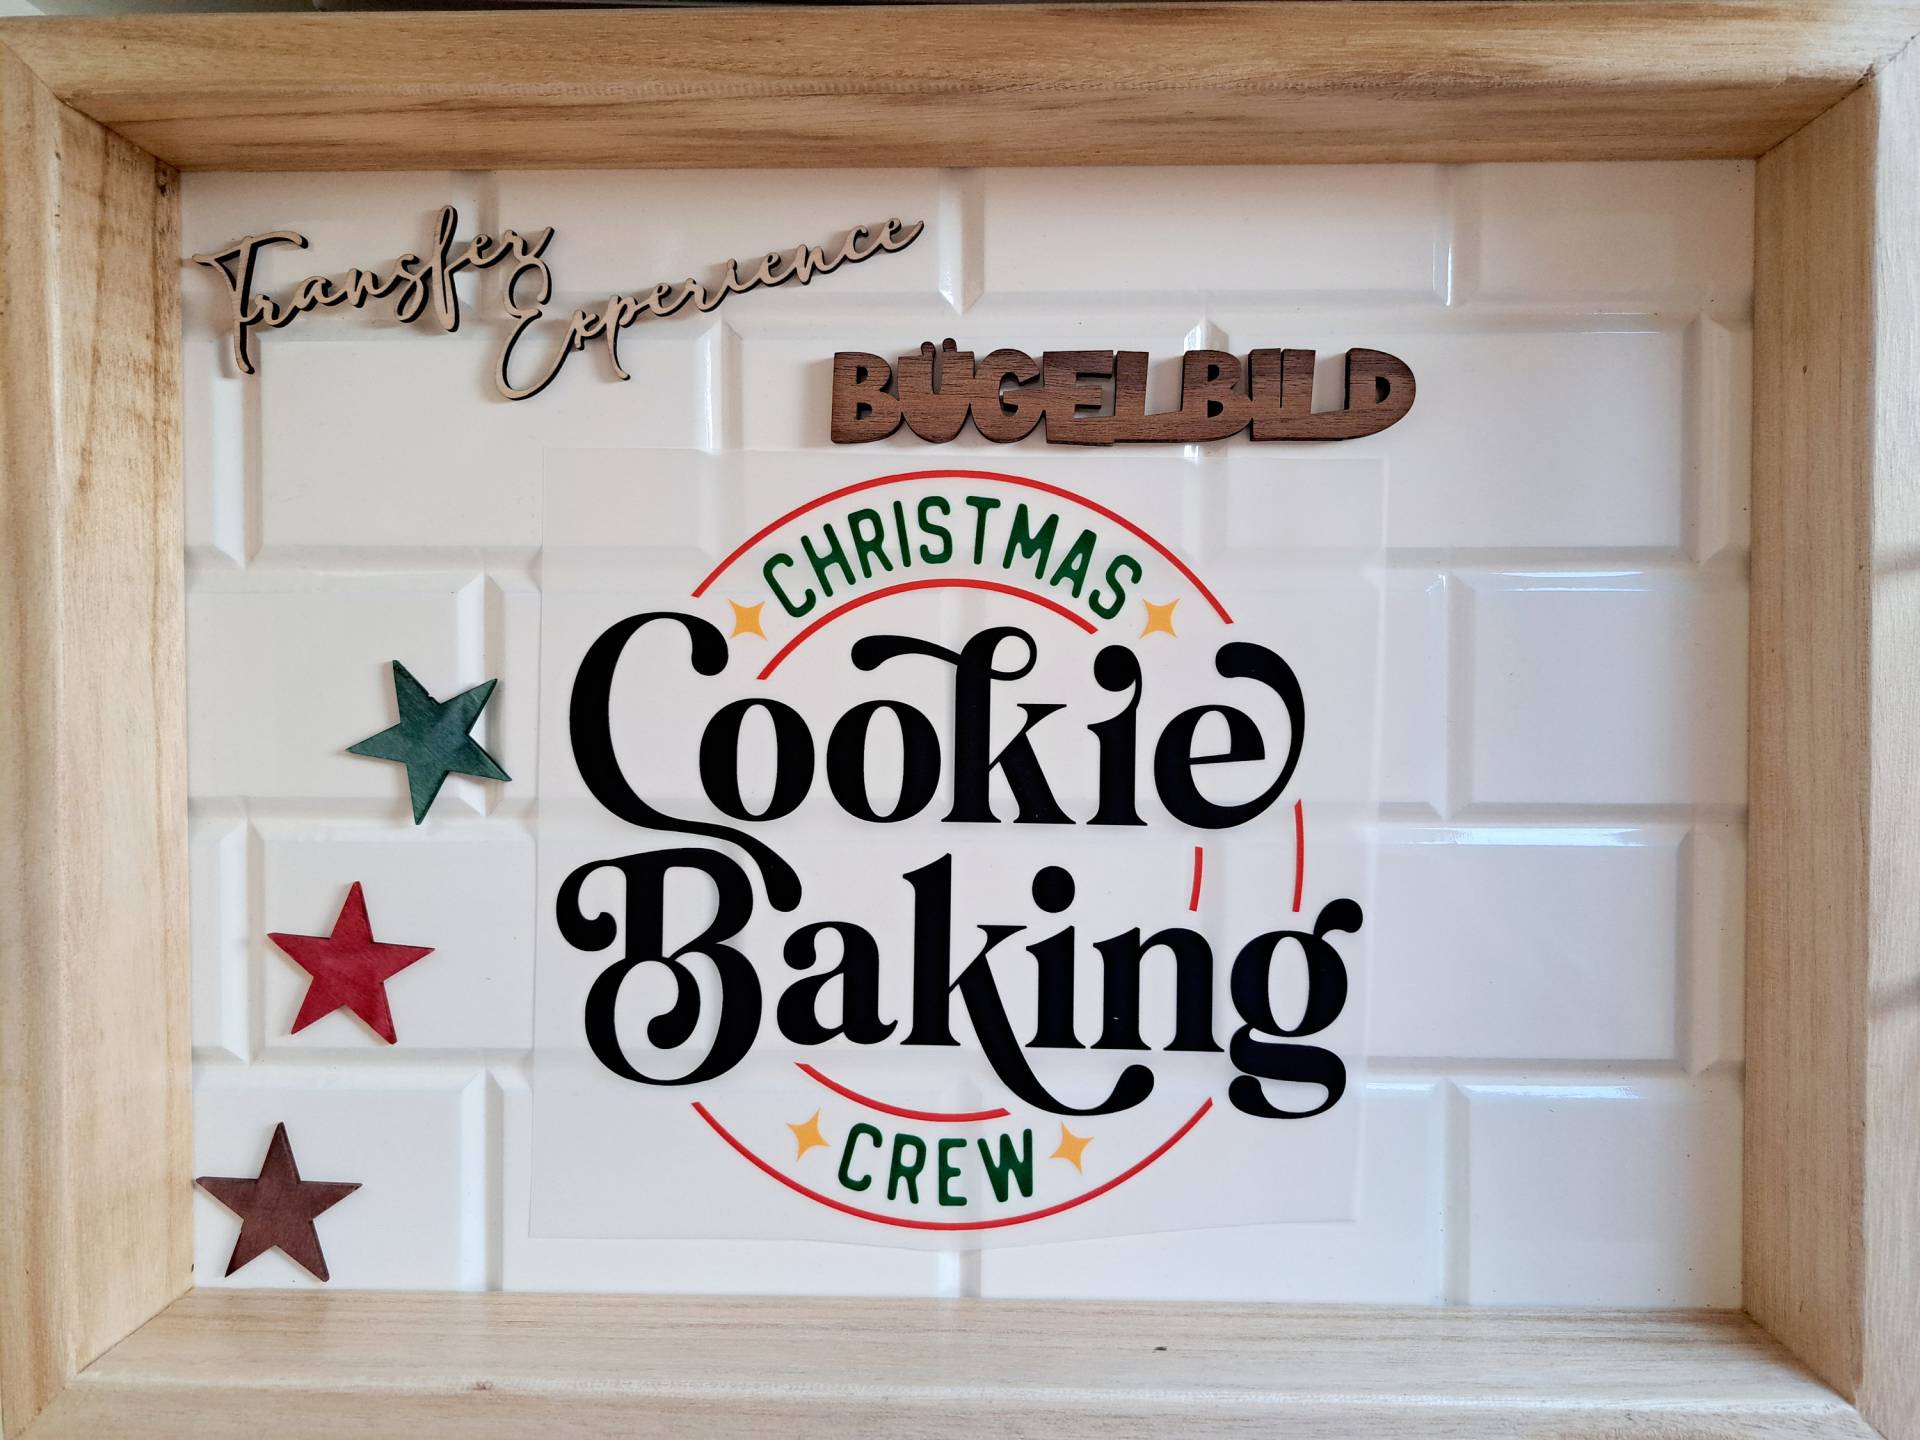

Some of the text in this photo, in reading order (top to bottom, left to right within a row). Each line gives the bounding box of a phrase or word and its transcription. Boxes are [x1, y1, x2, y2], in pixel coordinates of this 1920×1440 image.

[193, 205, 555, 375] Transfer
[495, 217, 925, 401] Experience
[831, 338, 1416, 446] BÜGELBILD
[762, 495, 1143, 620] CHRISTMAS
[569, 611, 1306, 913] Cookie
[556, 847, 1364, 1120] Baking
[837, 1122, 1034, 1207] CREW
